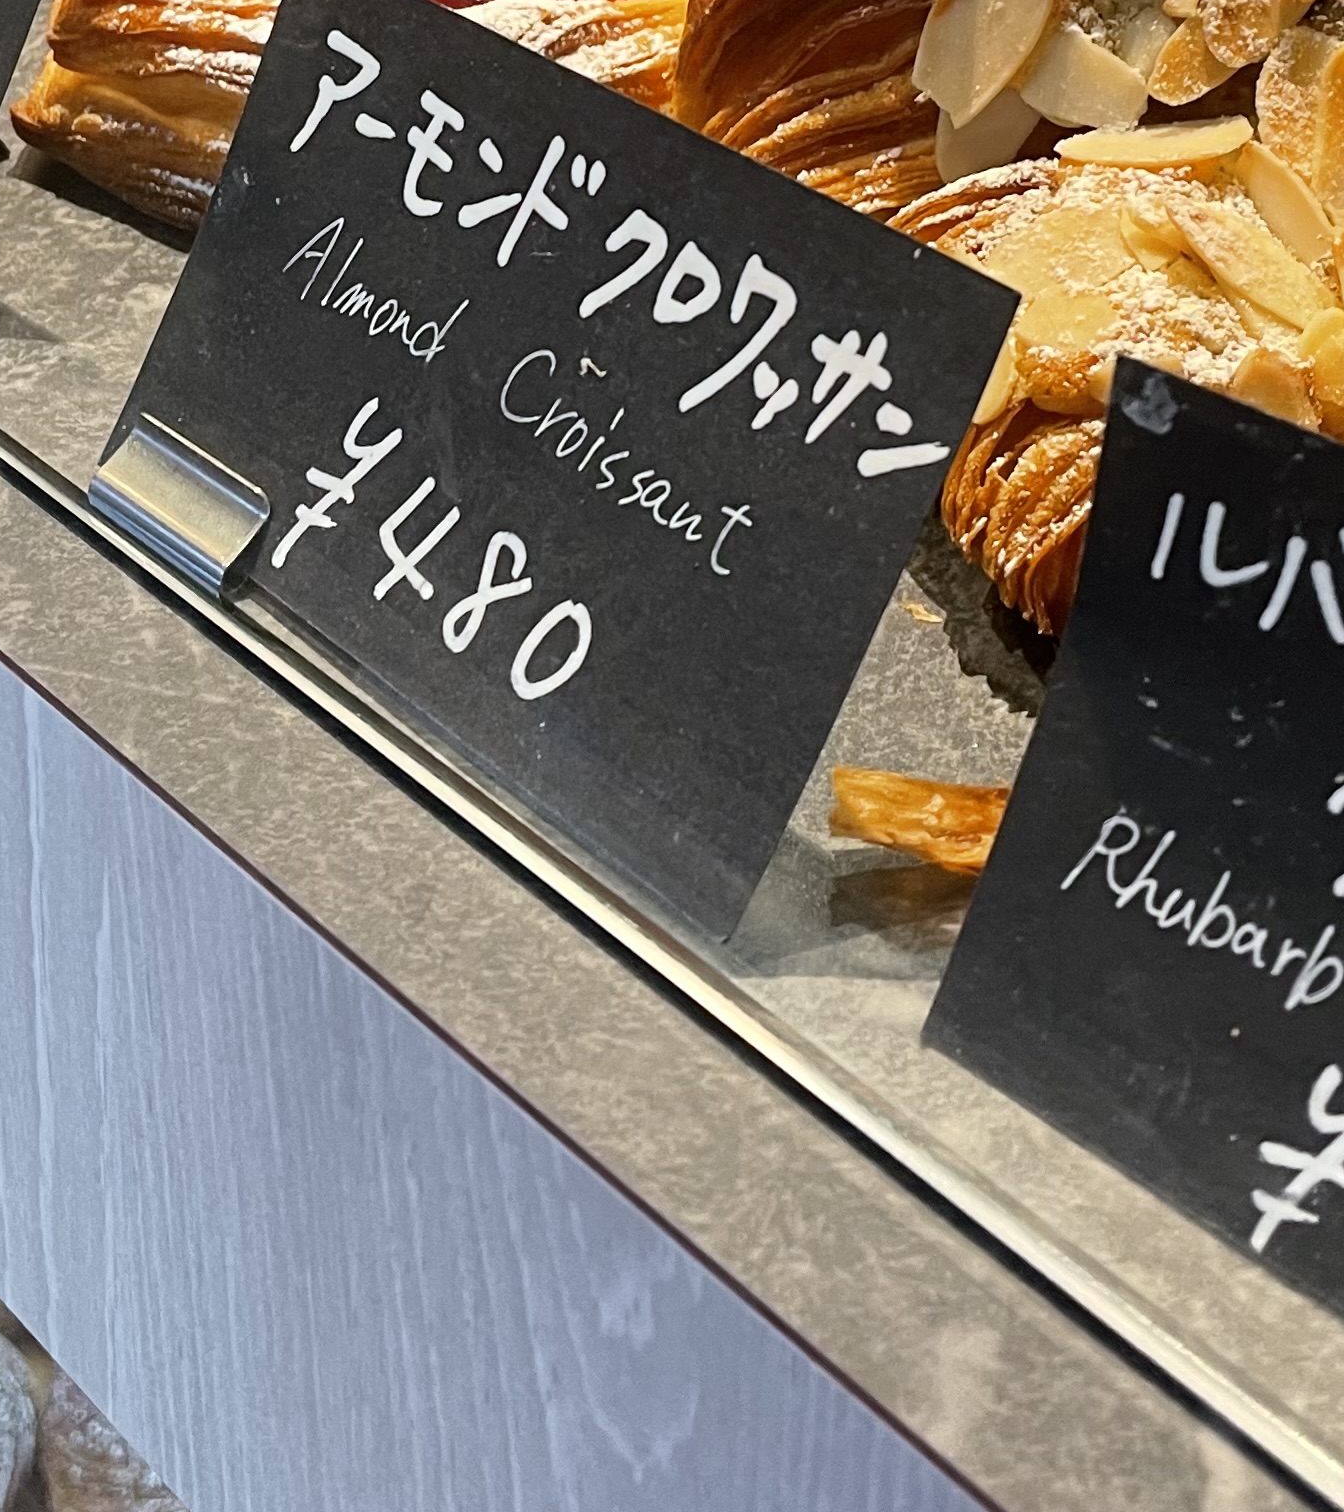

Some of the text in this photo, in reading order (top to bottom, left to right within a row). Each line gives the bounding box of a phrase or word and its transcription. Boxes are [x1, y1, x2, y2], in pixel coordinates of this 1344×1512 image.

[271, 396, 594, 701] ¥480
[282, 216, 754, 576] Almond Croissant
